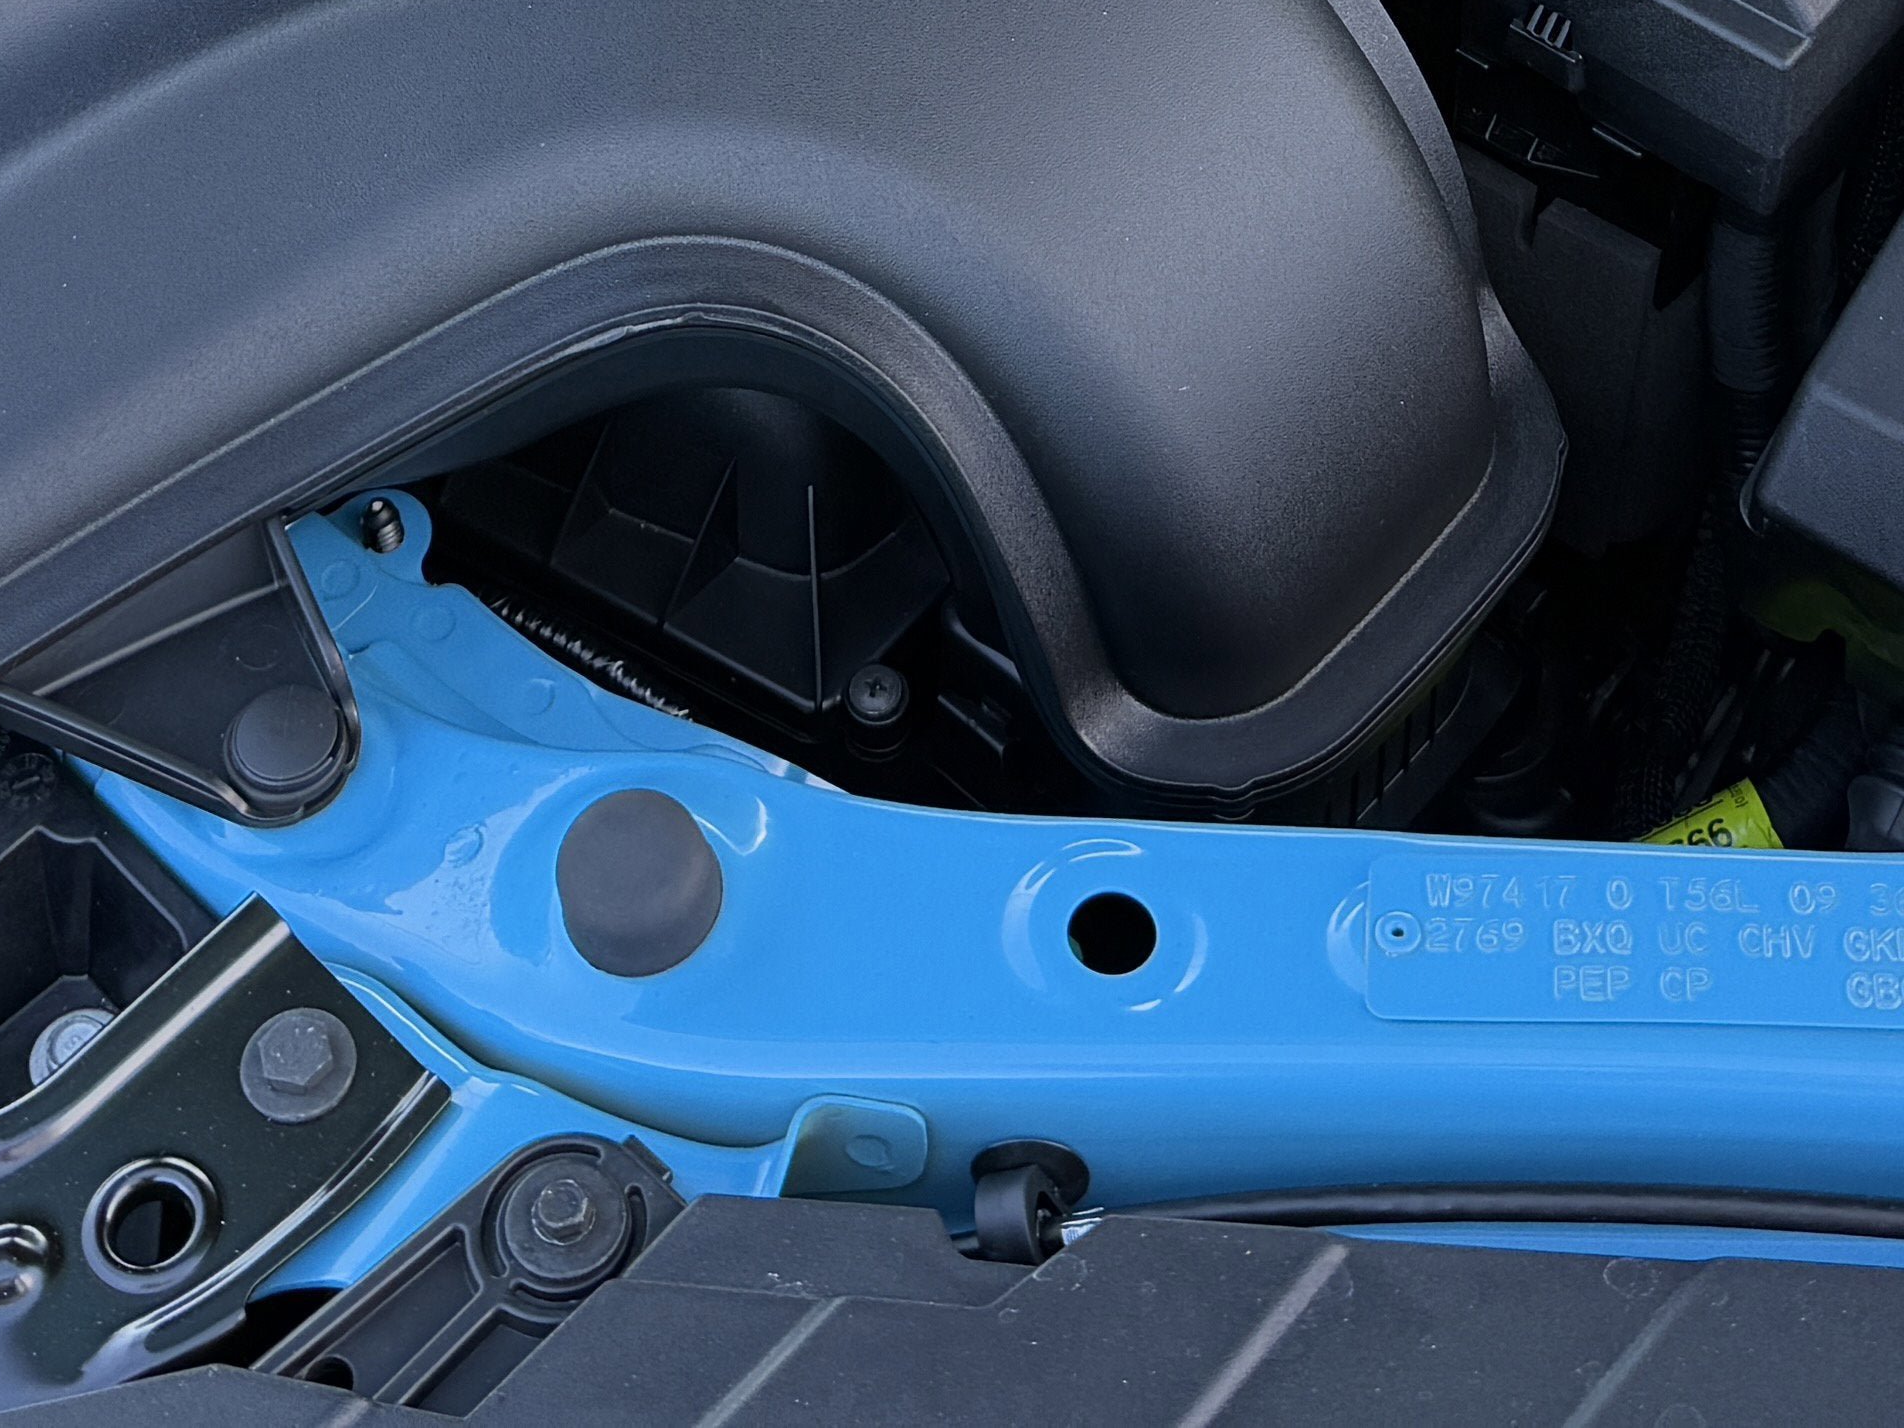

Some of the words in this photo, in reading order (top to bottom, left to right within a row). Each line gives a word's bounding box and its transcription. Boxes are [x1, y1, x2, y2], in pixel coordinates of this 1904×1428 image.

[1658, 876, 1760, 913] T56L
[1788, 880, 1838, 915] 09
[1423, 916, 1526, 954] 2769
[1552, 917, 1634, 956] BXQ
[1658, 921, 1709, 957] UC
[1738, 923, 1816, 960] CHV
[1553, 964, 1633, 1003] PEP
[1658, 965, 1712, 1003] CP
